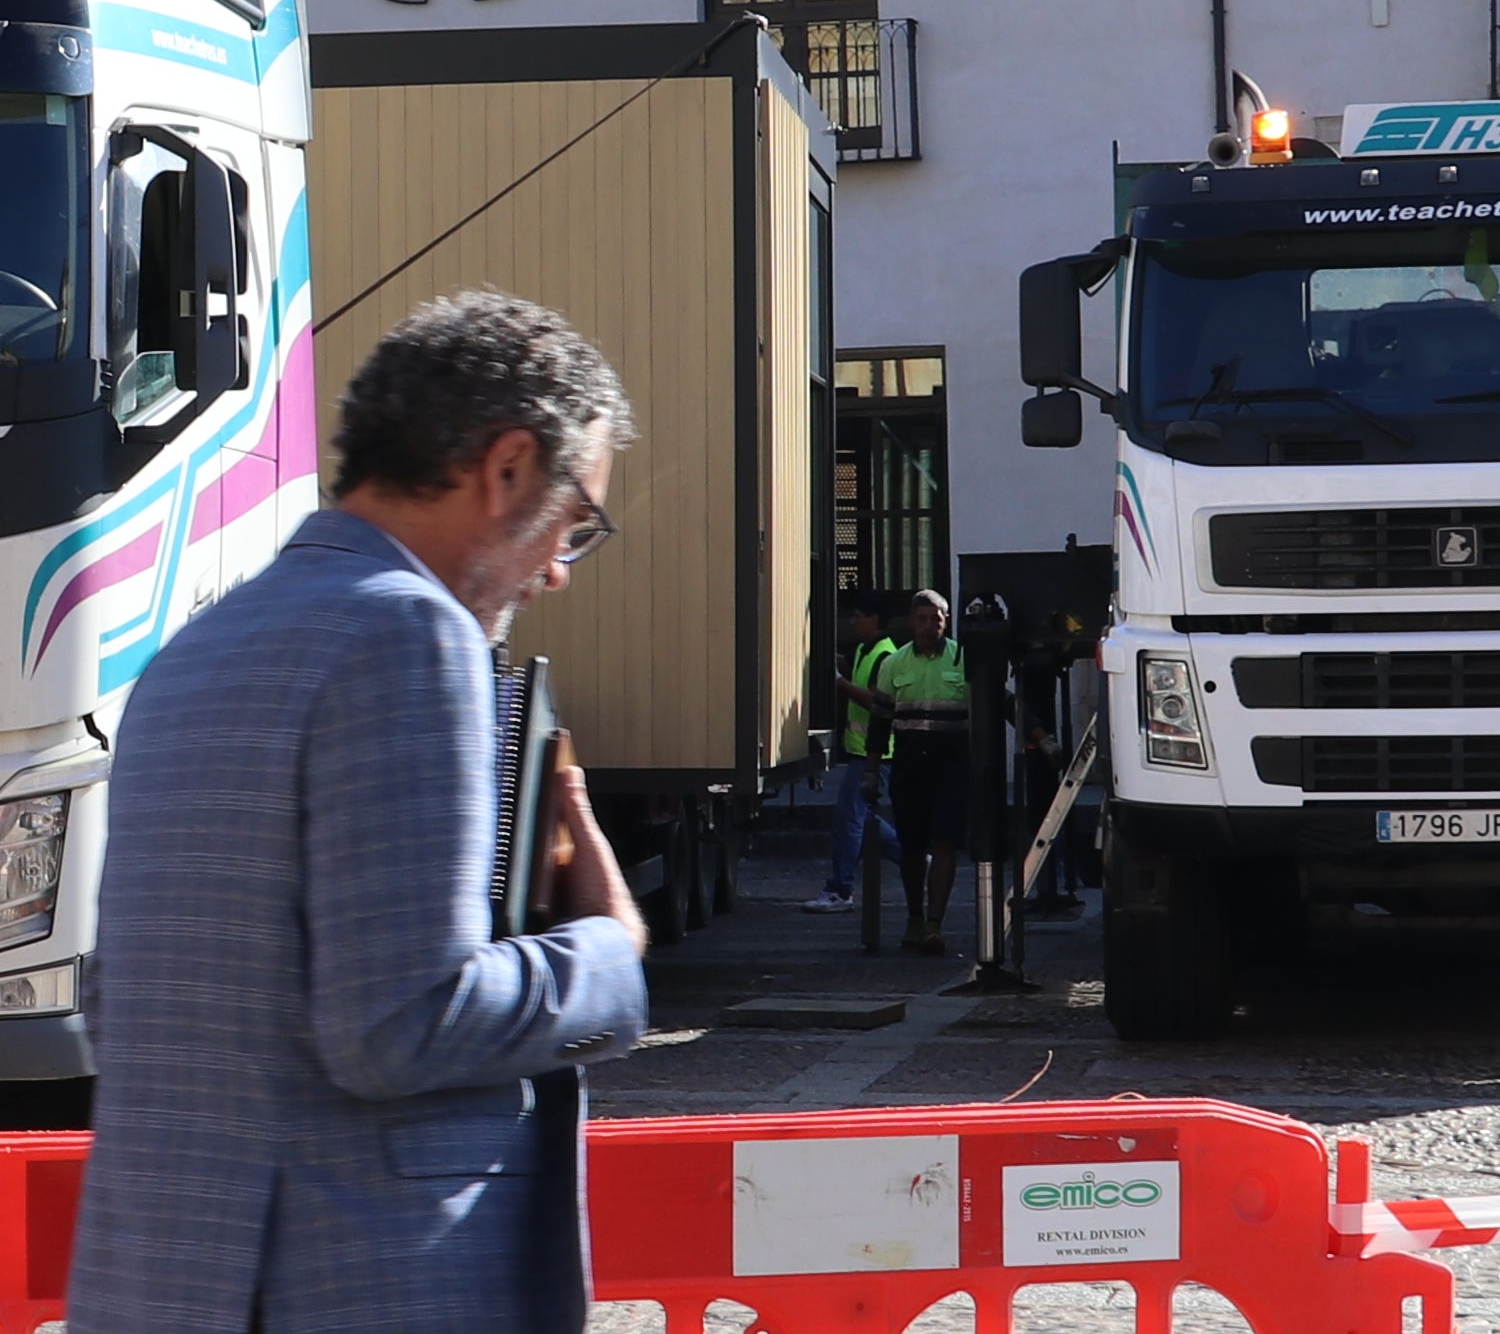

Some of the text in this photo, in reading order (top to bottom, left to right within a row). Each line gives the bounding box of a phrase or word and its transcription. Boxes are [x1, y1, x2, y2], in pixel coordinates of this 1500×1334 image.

[1398, 814, 1463, 837] 1796
[1020, 1171, 1162, 1210] emico
[1037, 1229, 1147, 1242] RENTAL DIVISION
[1056, 1244, 1128, 1256] www.emico.es
